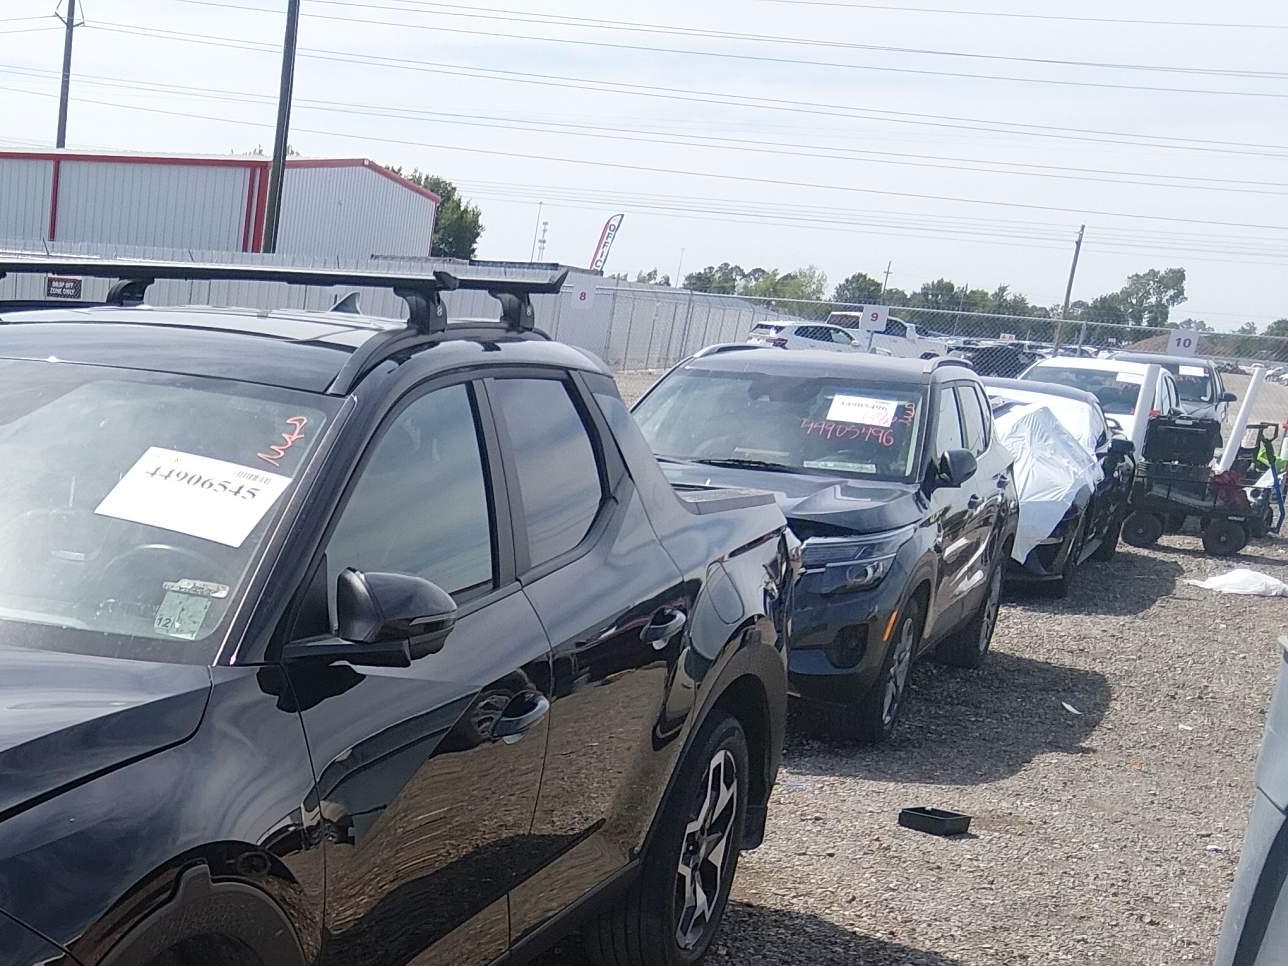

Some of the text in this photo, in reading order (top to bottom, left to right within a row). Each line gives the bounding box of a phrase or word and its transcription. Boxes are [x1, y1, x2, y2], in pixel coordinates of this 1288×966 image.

[594, 223, 617, 268] OFFIC
[579, 291, 586, 301] 8
[870, 312, 879, 322] 9
[1175, 337, 1192, 348] 10
[145, 466, 261, 500] 44906545
